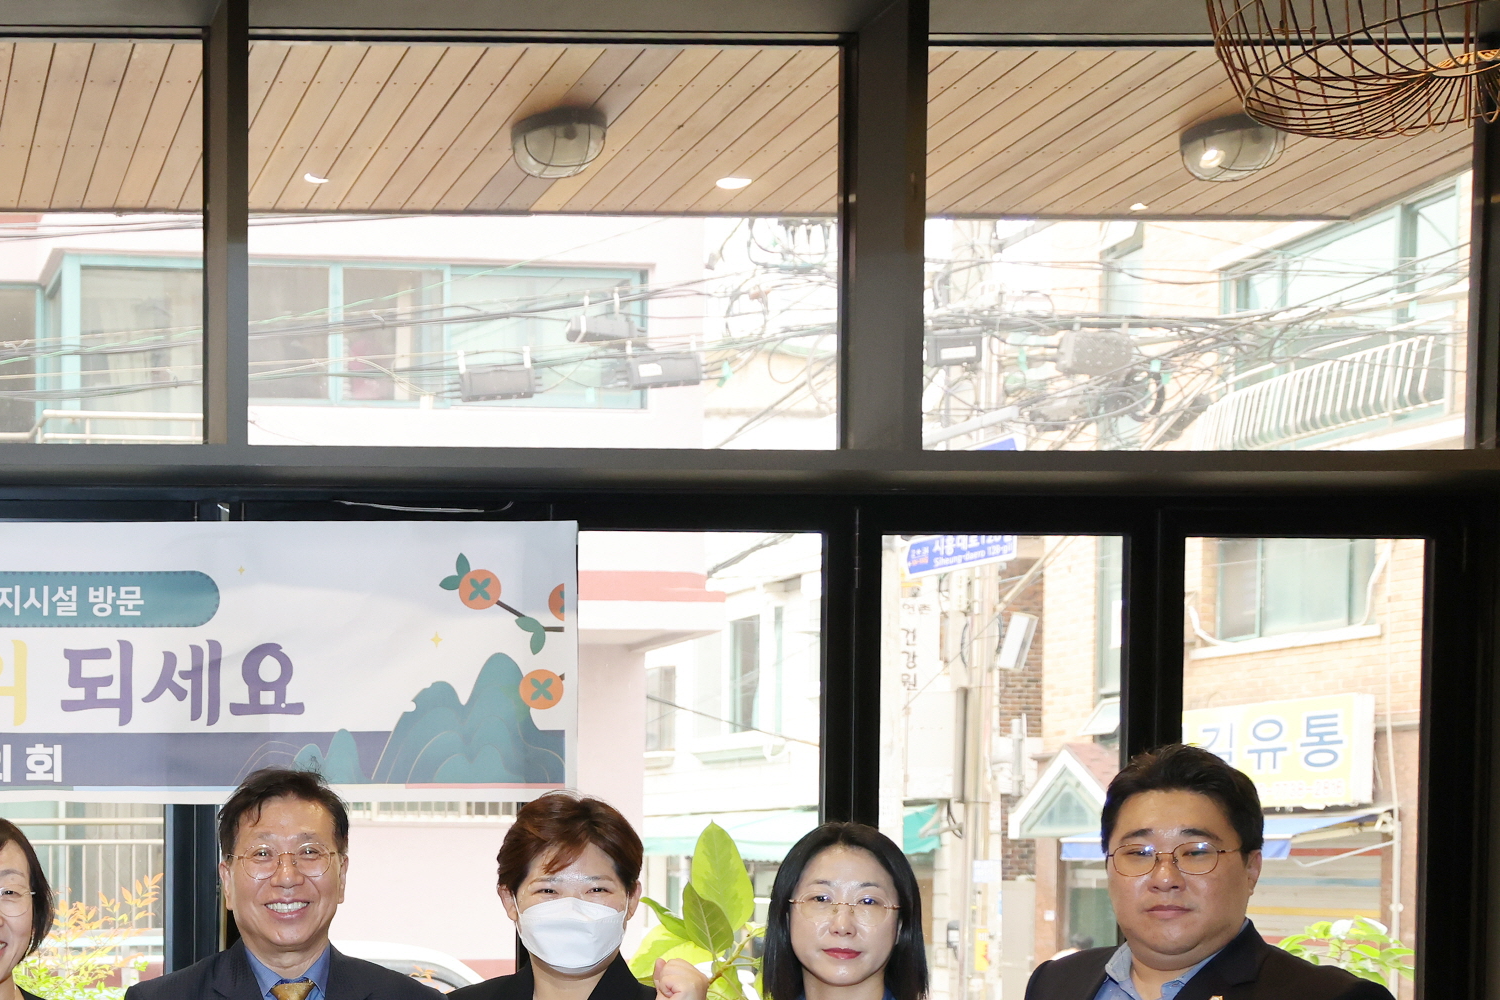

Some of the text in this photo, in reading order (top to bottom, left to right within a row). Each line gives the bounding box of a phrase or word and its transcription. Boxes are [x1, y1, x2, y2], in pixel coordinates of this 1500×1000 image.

[933, 548, 986, 568] Siheung-daero
[88, 585, 145, 617] 방문
[60, 639, 306, 727] 되세요
